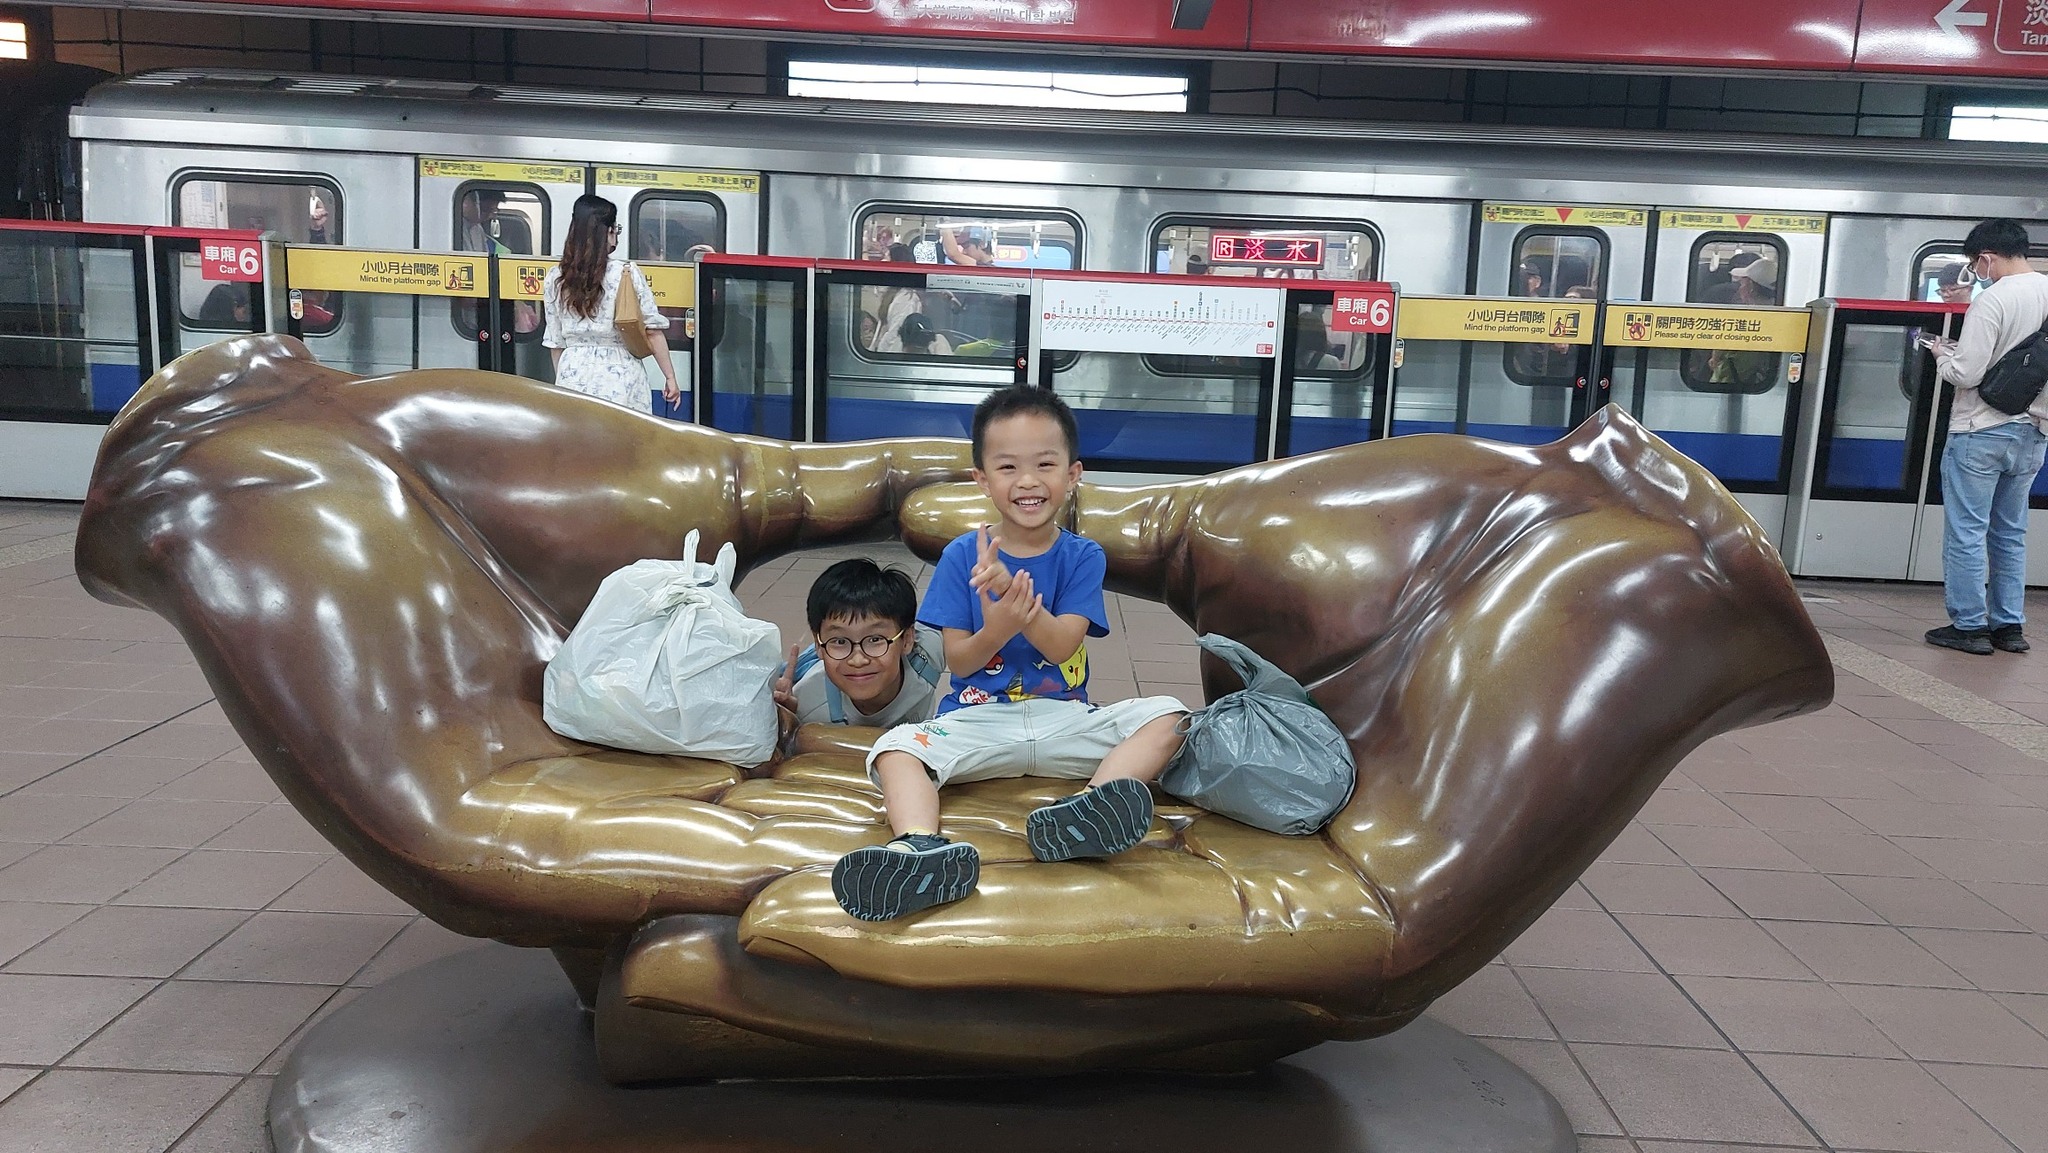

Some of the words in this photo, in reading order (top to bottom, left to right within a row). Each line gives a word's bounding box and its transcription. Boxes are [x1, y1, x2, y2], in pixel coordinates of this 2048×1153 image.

[205, 246, 236, 262] 車廂
[239, 247, 259, 275] 6
[220, 265, 237, 274] Car
[361, 260, 440, 276] 小心月台間隙
[360, 275, 379, 283] Mind
[380, 276, 393, 284] the
[394, 277, 425, 287] platform
[427, 280, 441, 288] gap
[1336, 297, 1369, 314] 車廂
[1370, 299, 1390, 327] 6
[1467, 309, 1546, 324] 小心月台間隙
[1350, 316, 1367, 325] Car
[1655, 315, 1761, 333] 關門時勿強行進出
[1464, 323, 1483, 331] Mind
[1484, 324, 1496, 332] the
[1498, 325, 1529, 334] platform
[1531, 327, 1546, 335] gap
[1654, 330, 1678, 339] Please
[1680, 332, 1695, 341] stay
[1697, 332, 1714, 341] clear
[1715, 333, 1723, 342] of
[1724, 334, 1750, 344] closing
[1752, 335, 1773, 344] doors
